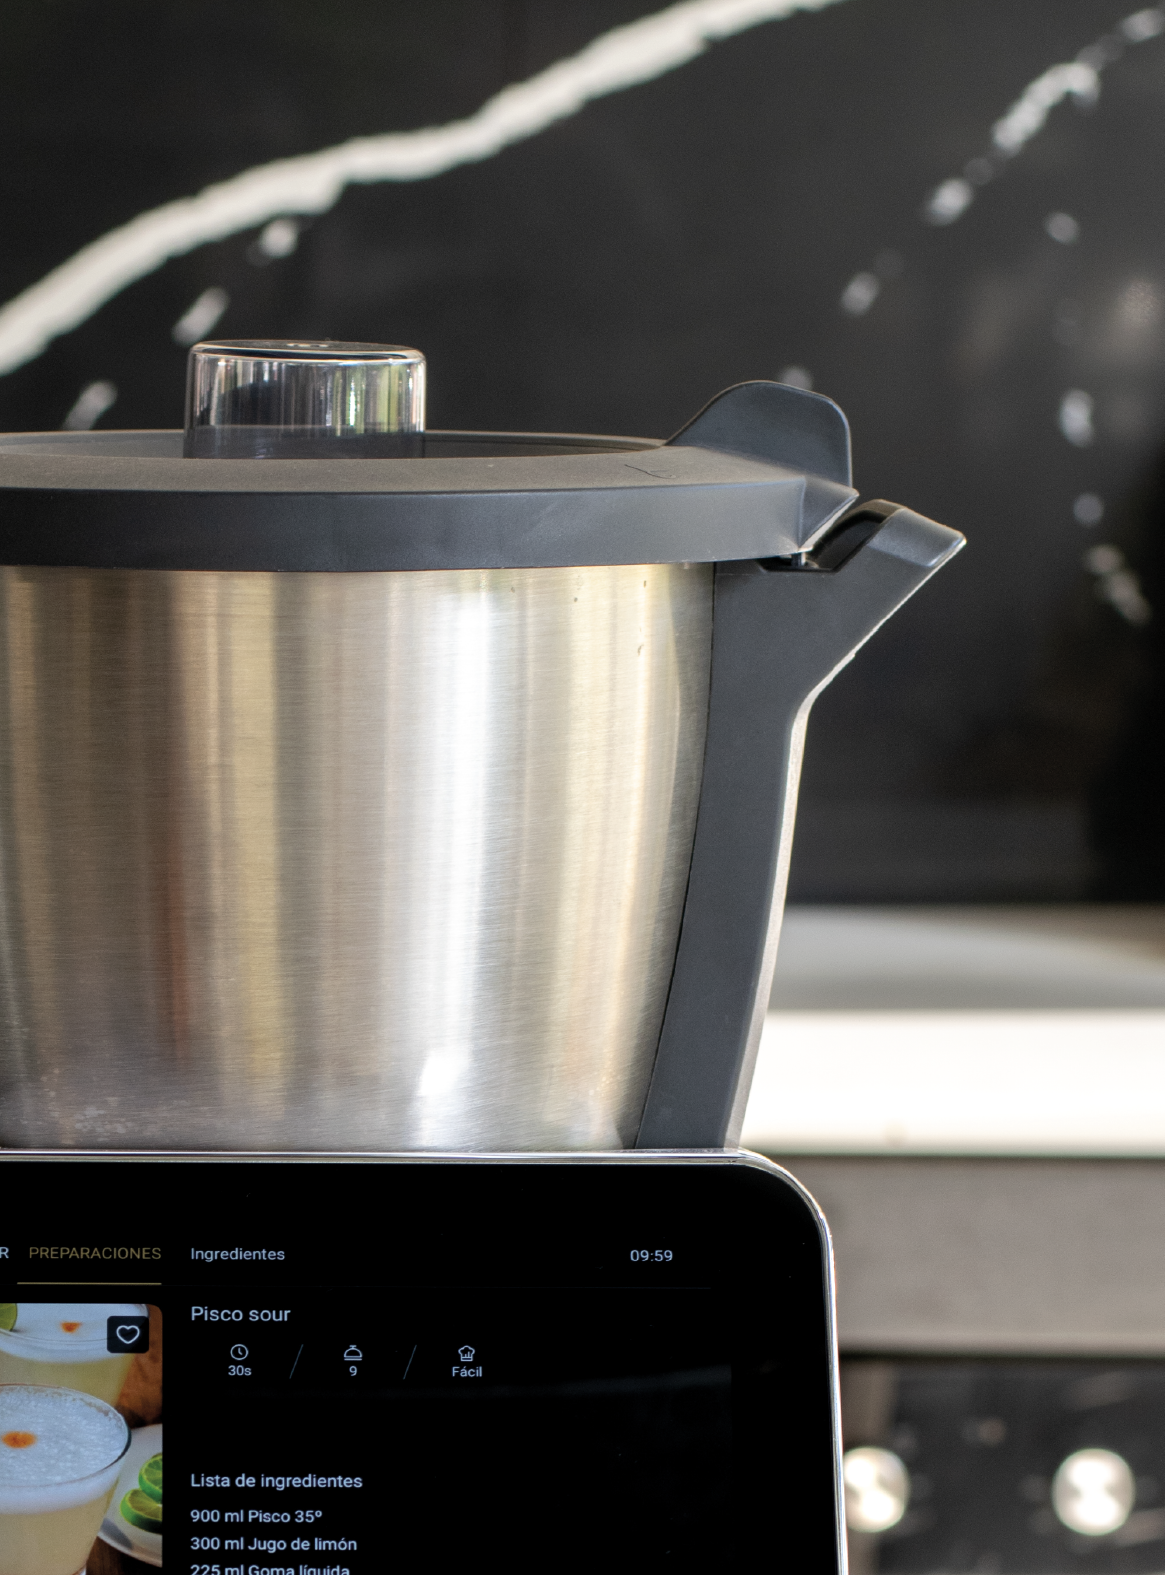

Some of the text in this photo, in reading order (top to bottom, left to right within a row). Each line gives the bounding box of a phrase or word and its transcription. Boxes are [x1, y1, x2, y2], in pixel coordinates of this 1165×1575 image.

[29, 1246, 162, 1260] PREPARACIONES
[190, 1247, 286, 1263] Ingredientes
[629, 1249, 673, 1262] 09:59
[191, 1305, 292, 1322] Pisco sour
[227, 1364, 252, 1377] 30s
[348, 1365, 358, 1377] 9
[451, 1365, 483, 1378] Fácil
[190, 1472, 364, 1492] Lista de ingredientes
[189, 1508, 221, 1523] 900
[224, 1509, 245, 1523] ml
[247, 1509, 291, 1523] Pisco
[190, 1536, 358, 1554] 300 ml Jugo de limón
